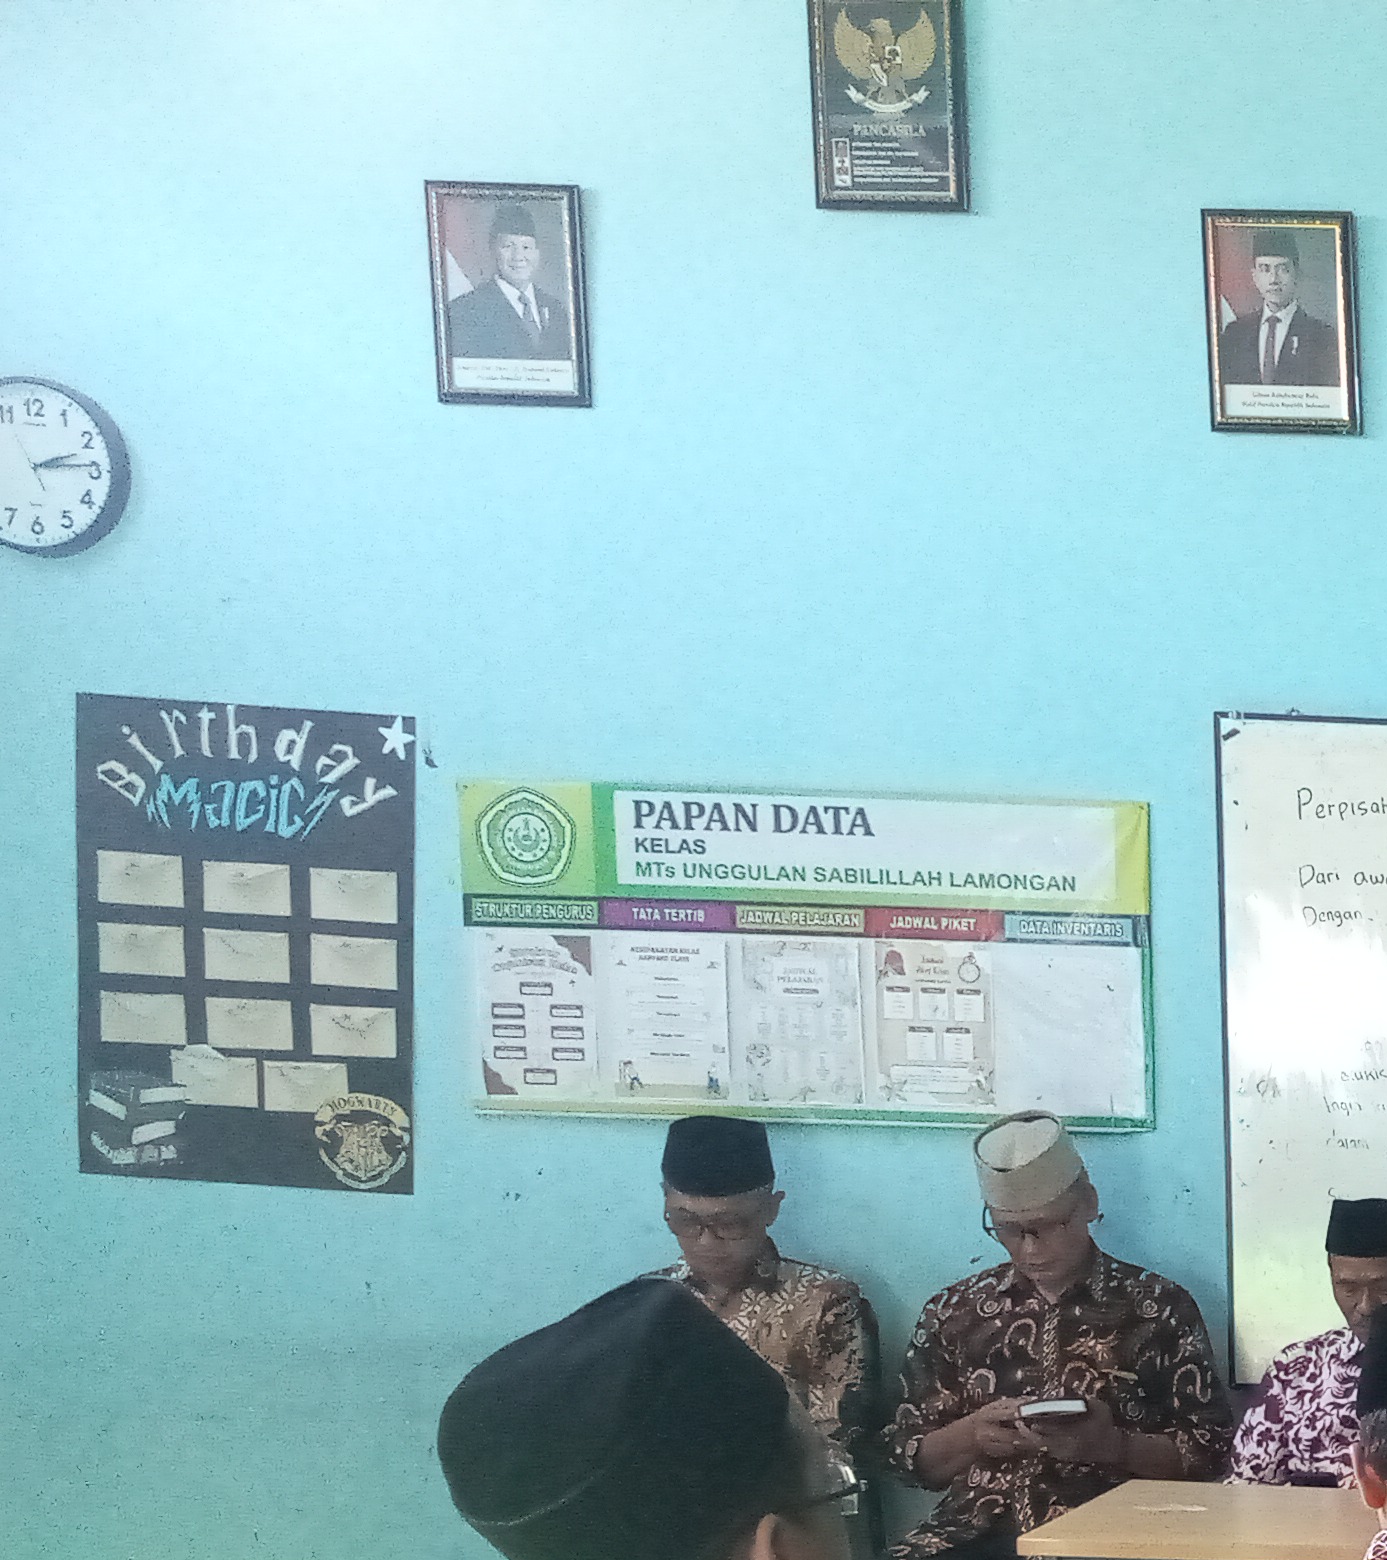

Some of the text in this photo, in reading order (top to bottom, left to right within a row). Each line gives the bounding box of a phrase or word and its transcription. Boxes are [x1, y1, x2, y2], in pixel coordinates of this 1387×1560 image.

[23, 397, 45, 418] 12
[60, 408, 69, 428] 1
[81, 431, 95, 450] 2
[88, 460, 102, 480] 3
[79, 488, 96, 510] 4
[4, 506, 18, 528] 7
[31, 515, 45, 536] 6
[60, 509, 75, 530] 5
[632, 799, 876, 837] PAPAN DATA
[634, 837, 707, 855] KELAS
[635, 861, 1077, 893] MTs UNGGULAN SABILILLAH LAMONGAN
[1299, 864, 1340, 889] Dari
[474, 902, 595, 921] STRUKTUR PENGURUS
[631, 906, 705, 923] TATA TERTIB
[739, 908, 860, 929] JADWAL PELAJARAN
[889, 914, 977, 932] JADWAL PIKET
[1019, 919, 1124, 938] DATA INVENTARIS
